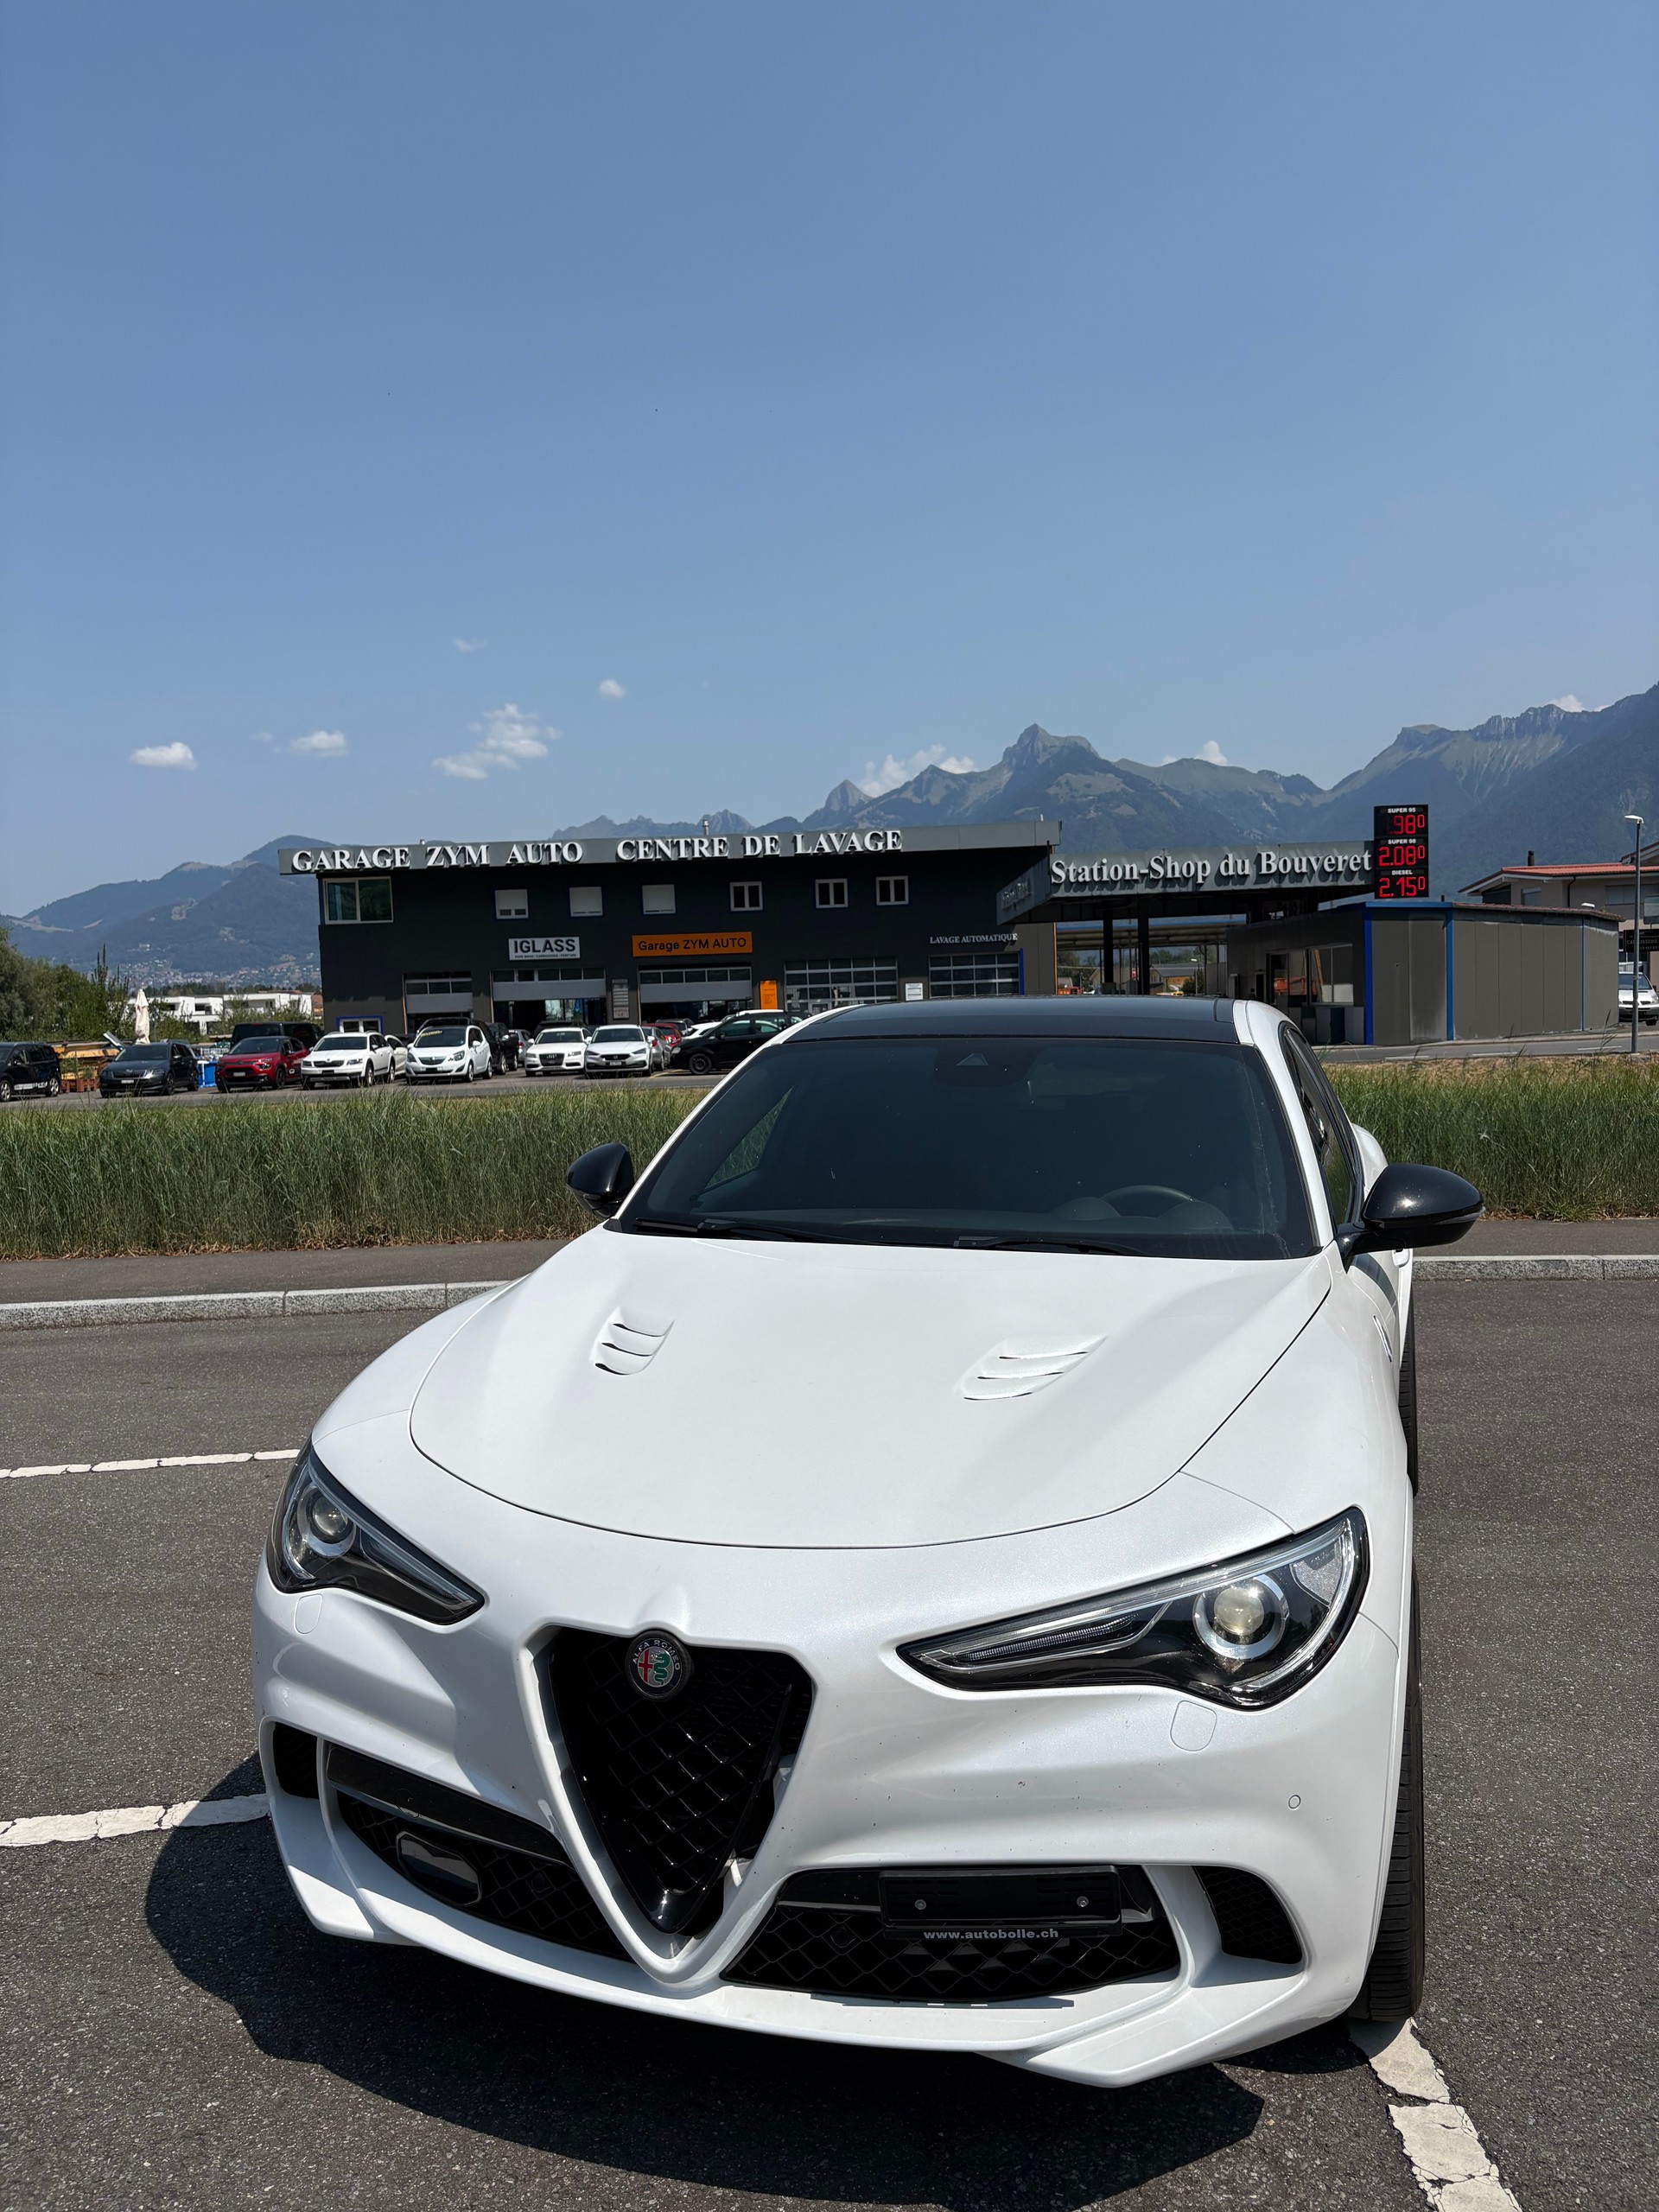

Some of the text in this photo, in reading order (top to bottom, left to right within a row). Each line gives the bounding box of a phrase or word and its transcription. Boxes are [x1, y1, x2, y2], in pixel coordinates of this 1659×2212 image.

[292, 830, 903, 872] GARAGE ZYM AUTO CENTRE DE LAVAGE
[1051, 849, 1372, 884] Station-Shop du Bouveret
[514, 938, 575, 954] IGLASS
[639, 937, 747, 952] Garage ZYM AUTO
[961, 933, 1018, 944] AUTOMATIQUE
[632, 1640, 680, 1670] ALFA ROMEO
[923, 1928, 1059, 1940] www.autobolle.ch
